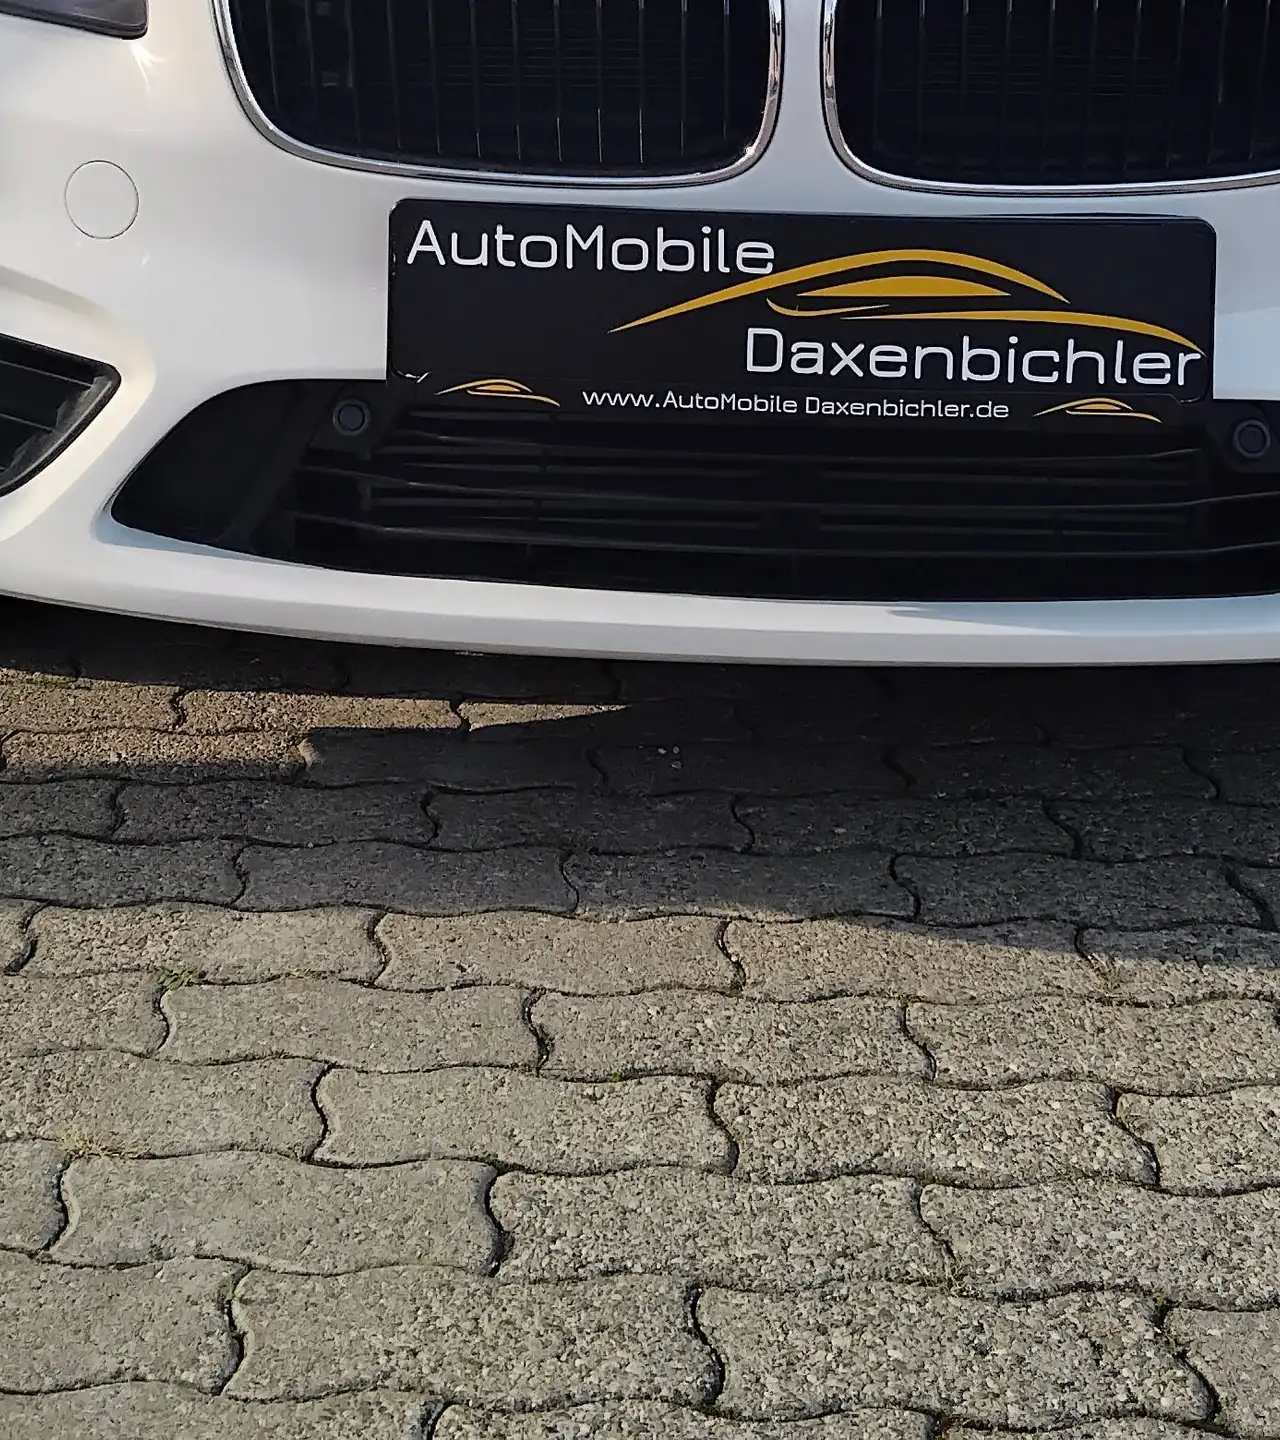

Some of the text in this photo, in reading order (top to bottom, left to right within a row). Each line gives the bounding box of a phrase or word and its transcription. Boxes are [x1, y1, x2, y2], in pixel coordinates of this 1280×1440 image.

[407, 220, 775, 274] AutoMobile
[746, 327, 1204, 386] Daxenbichler
[583, 390, 1009, 418] www.AutoMobile Daxenbichler.de
